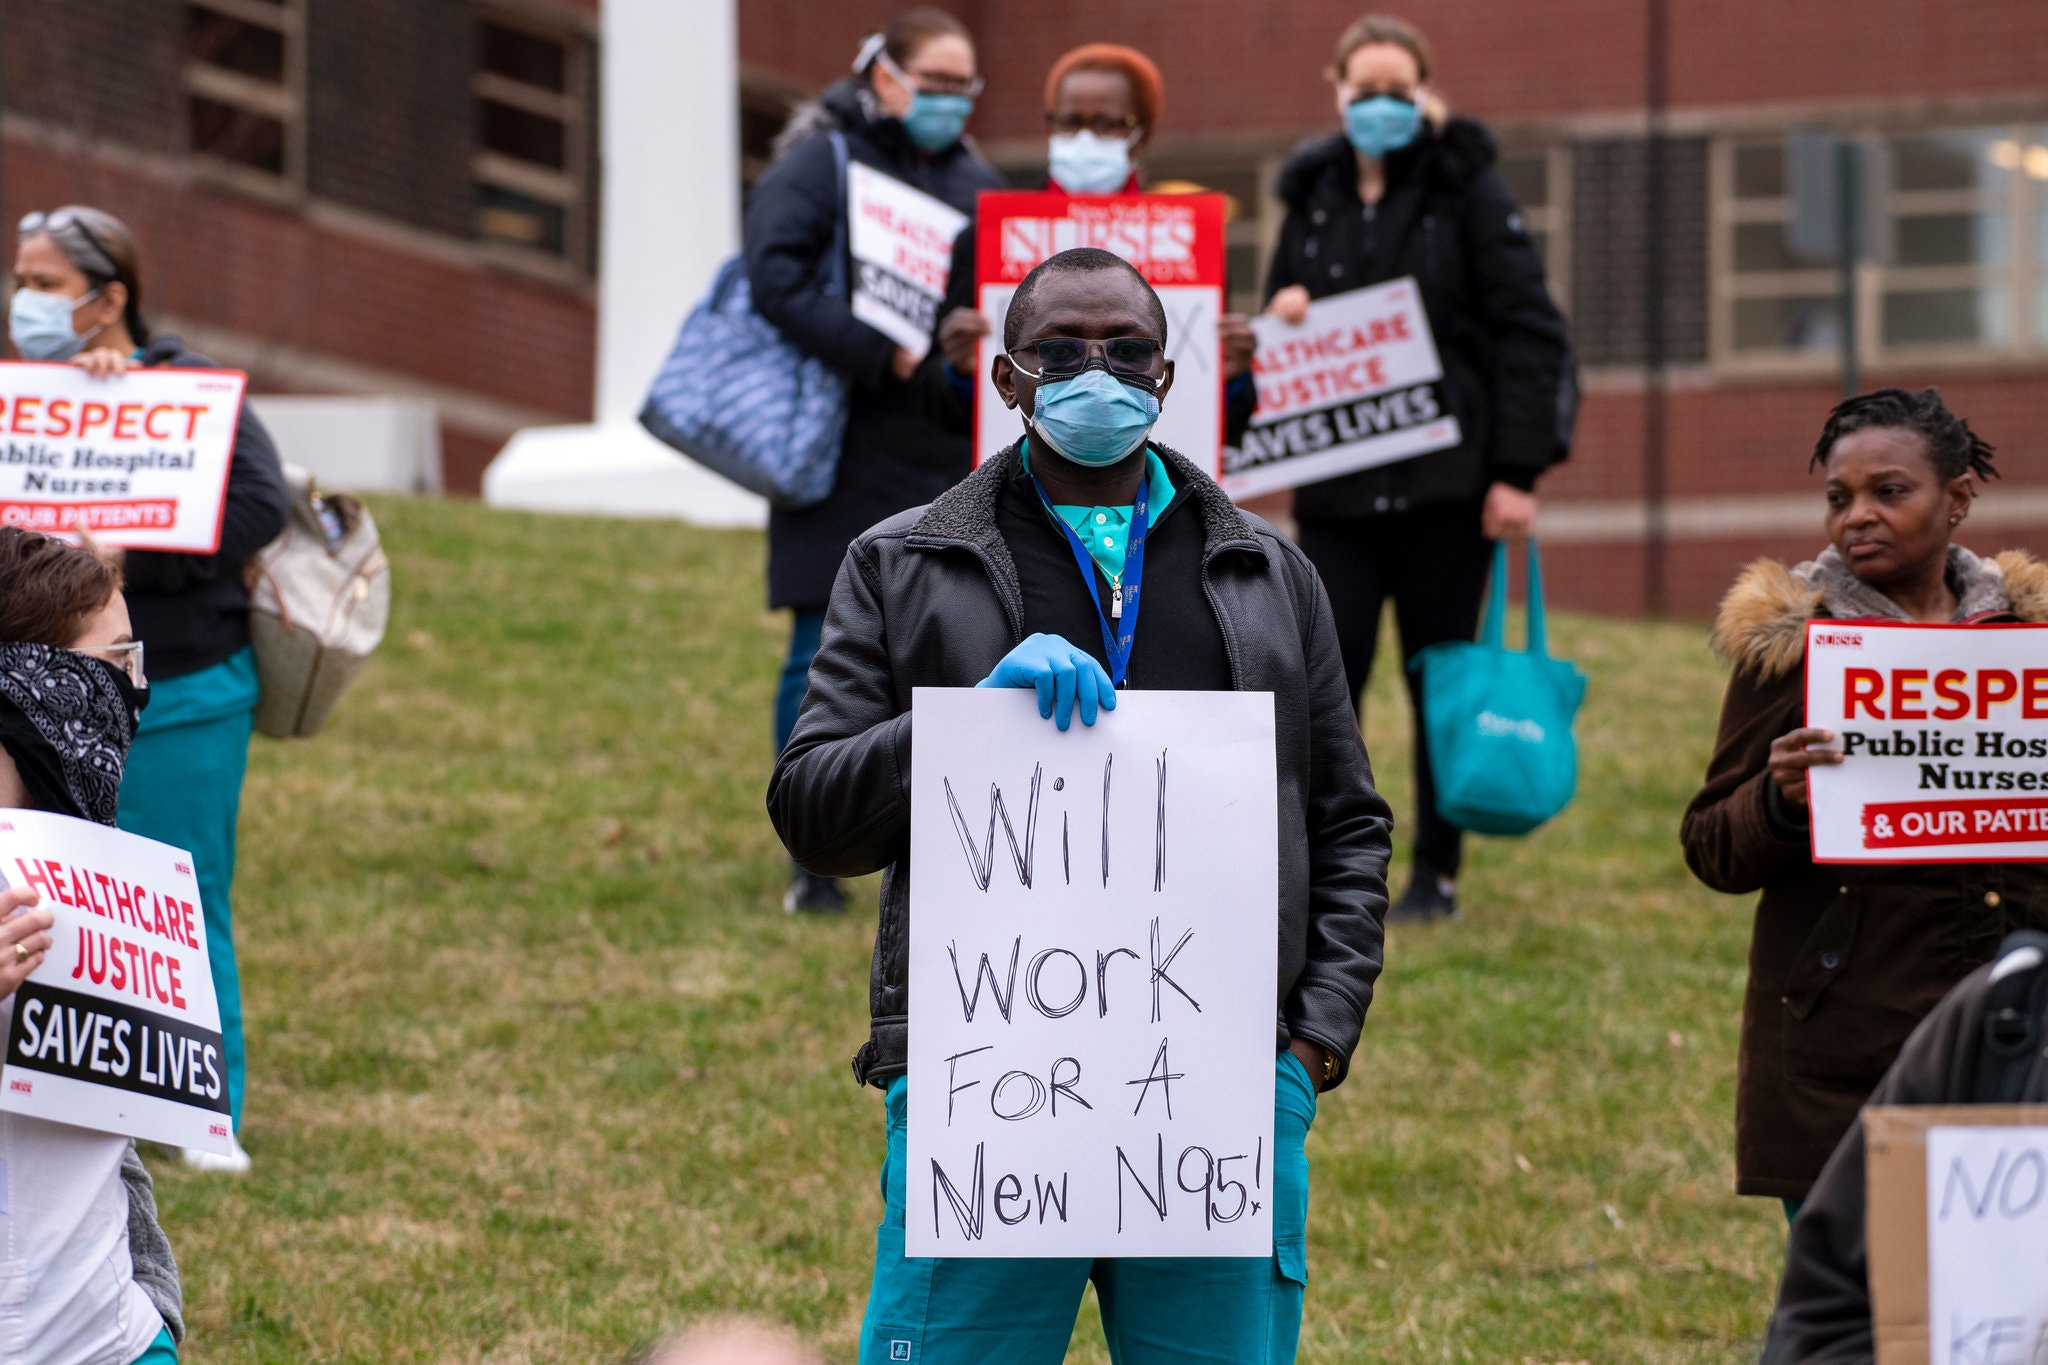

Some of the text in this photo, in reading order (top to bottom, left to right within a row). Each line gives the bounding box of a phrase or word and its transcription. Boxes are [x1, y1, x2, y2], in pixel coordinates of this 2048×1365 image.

[1001, 217, 1197, 266] NURSES
[0, 397, 209, 440] ESPECT
[1335, 387, 1440, 441] LIVES
[0, 443, 195, 472] blic Hospital
[24, 472, 131, 493] Nurses
[2, 503, 171, 527] OUR PATIENTS
[1843, 667, 2048, 721] RESPE
[1842, 730, 1964, 757] Public
[943, 747, 1168, 894] Will
[1872, 814, 1895, 839] &
[1901, 811, 1968, 837] OUR
[15, 857, 200, 951] HEALTHCARE
[71, 925, 187, 1011] JUSTICE
[18, 997, 222, 1101] SAVES LIVES
[1125, 1036, 1186, 1121] A
[930, 1141, 1069, 1242] New
